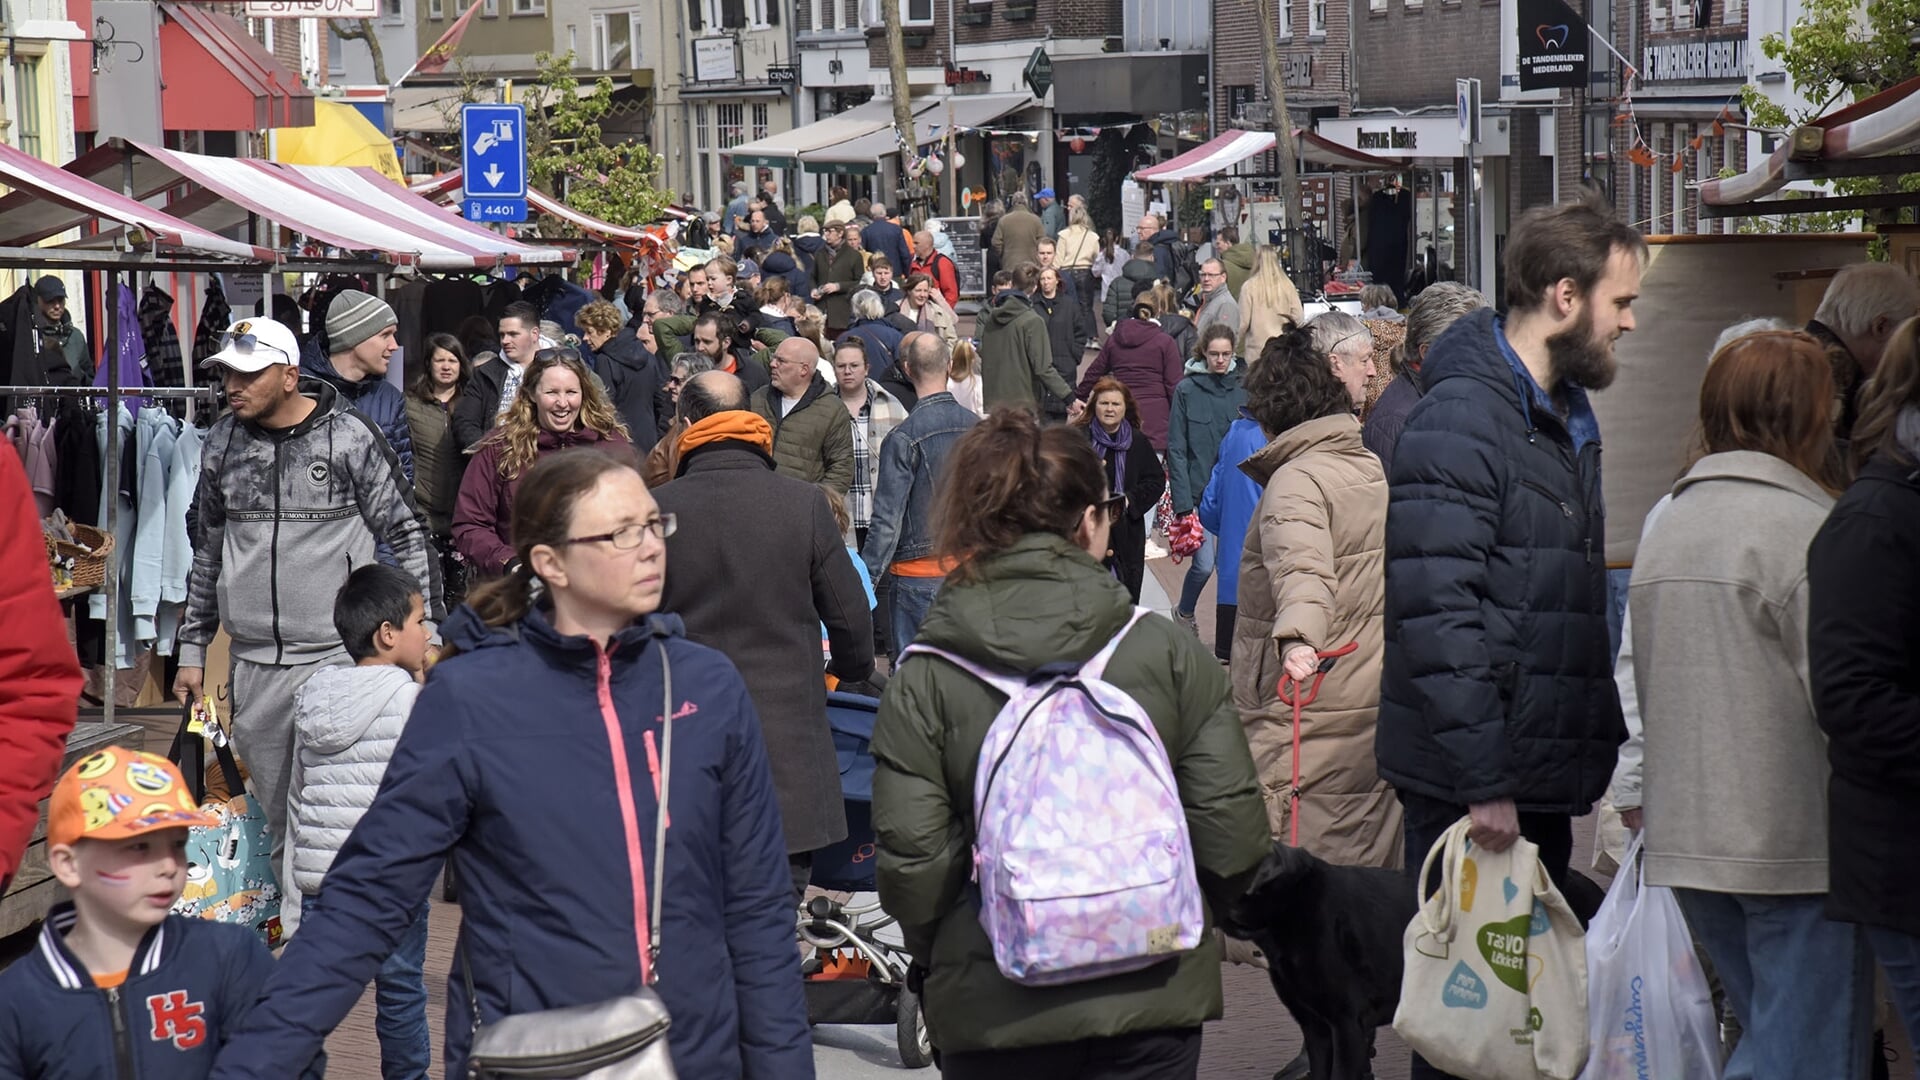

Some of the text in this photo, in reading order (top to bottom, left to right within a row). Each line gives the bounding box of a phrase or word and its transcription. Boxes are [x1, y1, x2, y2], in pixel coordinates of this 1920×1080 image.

[1522, 54, 1584, 65] DE TANDENBLEKER
[1654, 43, 1706, 80] TANDENBLEKER
[1708, 40, 1748, 78] NEDERLAN
[1533, 65, 1573, 74] NEDERLAND
[485, 206, 514, 215] 4401
